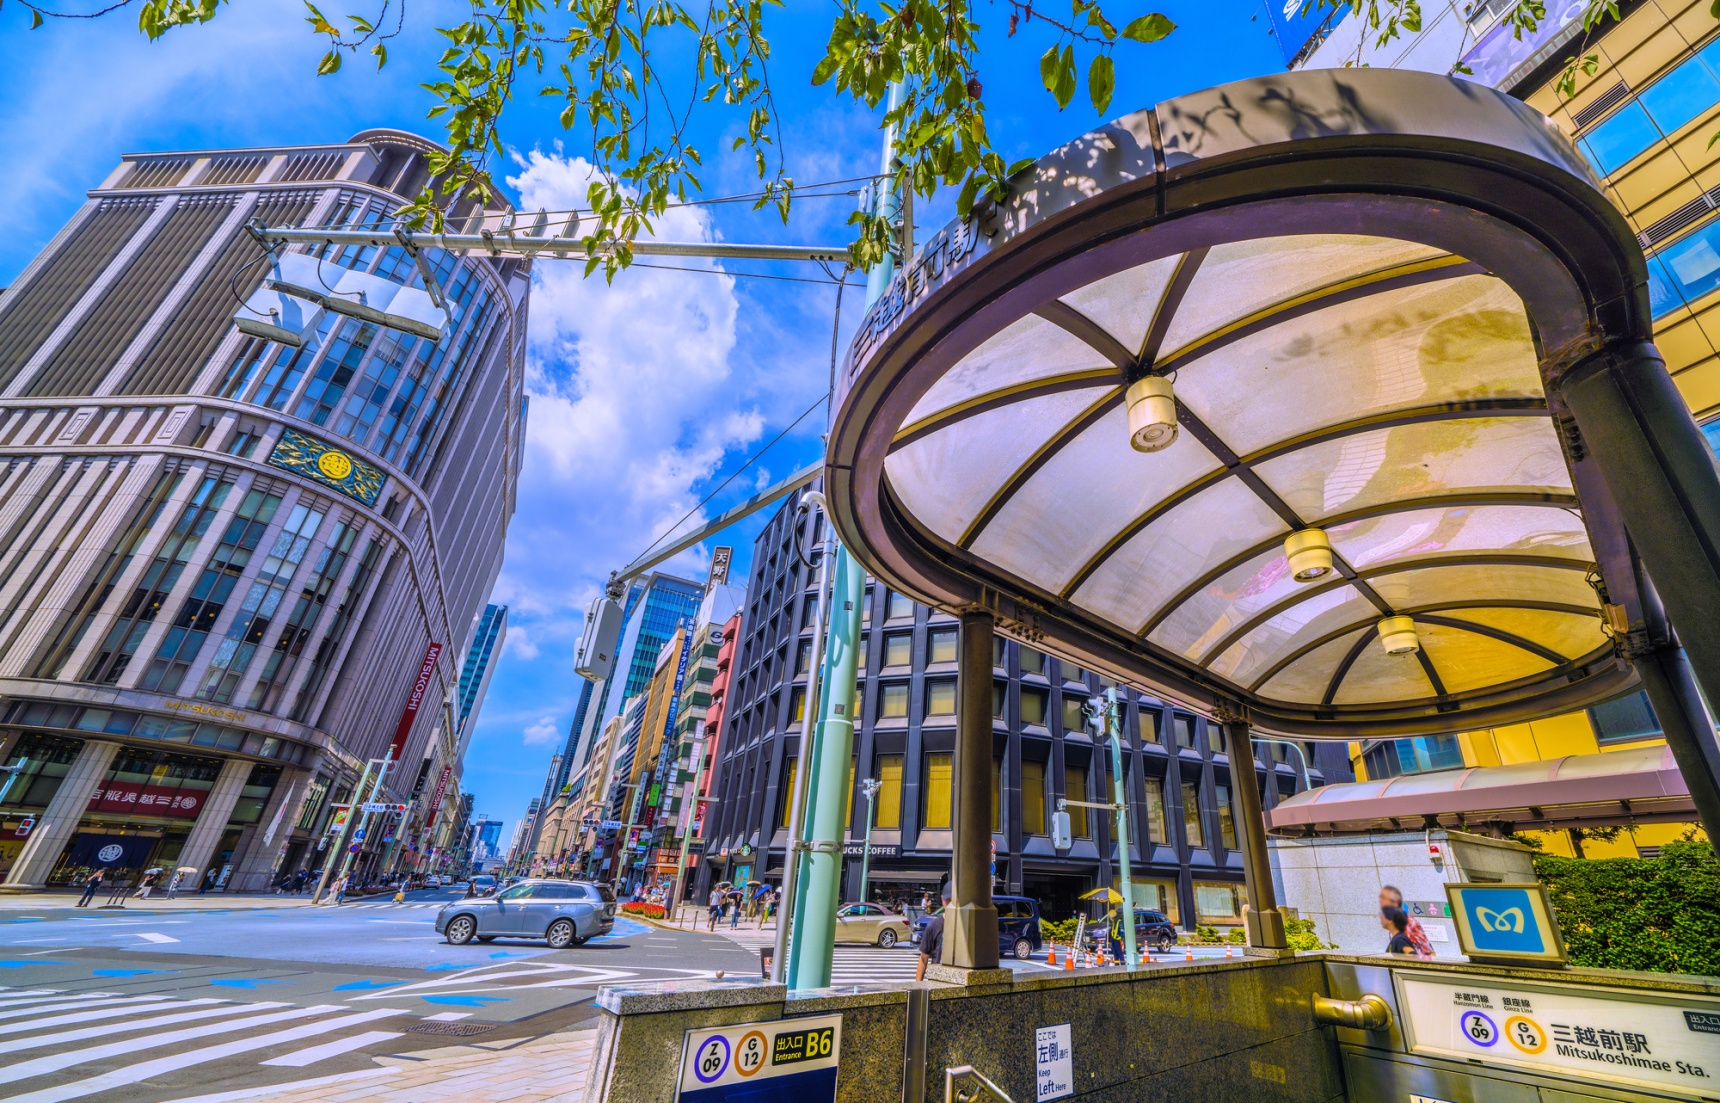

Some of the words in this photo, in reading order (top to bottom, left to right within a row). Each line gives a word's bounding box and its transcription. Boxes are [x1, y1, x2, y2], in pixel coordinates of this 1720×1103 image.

[408, 647, 439, 710] MITSUKOSHI
[164, 700, 247, 721] MITSUKOSHI
[1453, 1000, 1481, 1008] Hanzomon
[1502, 996, 1531, 1008] 銀座線
[1503, 1005, 1520, 1013] Ginza
[1472, 1016, 1483, 1027] Z
[1517, 1022, 1529, 1033] G
[1471, 1027, 1490, 1040] 09
[1693, 1024, 1720, 1033] Entranc
[1038, 1030, 1057, 1042] ここでは
[1517, 1033, 1538, 1046] 12
[1550, 1023, 1652, 1055] 三越前駅
[708, 1043, 719, 1056] Z
[747, 1038, 758, 1050] G
[776, 1035, 803, 1051] 出入口
[806, 1030, 832, 1058] B6
[744, 1052, 758, 1066] 12
[775, 1051, 802, 1062] Entrance
[1555, 1043, 1672, 1072] Mitsukoshimae
[1675, 1061, 1711, 1078] Sta.
[702, 1057, 721, 1073] 09
[1038, 1069, 1051, 1078] Keep
[1039, 1080, 1055, 1096] Left
[1055, 1083, 1067, 1092] Here
